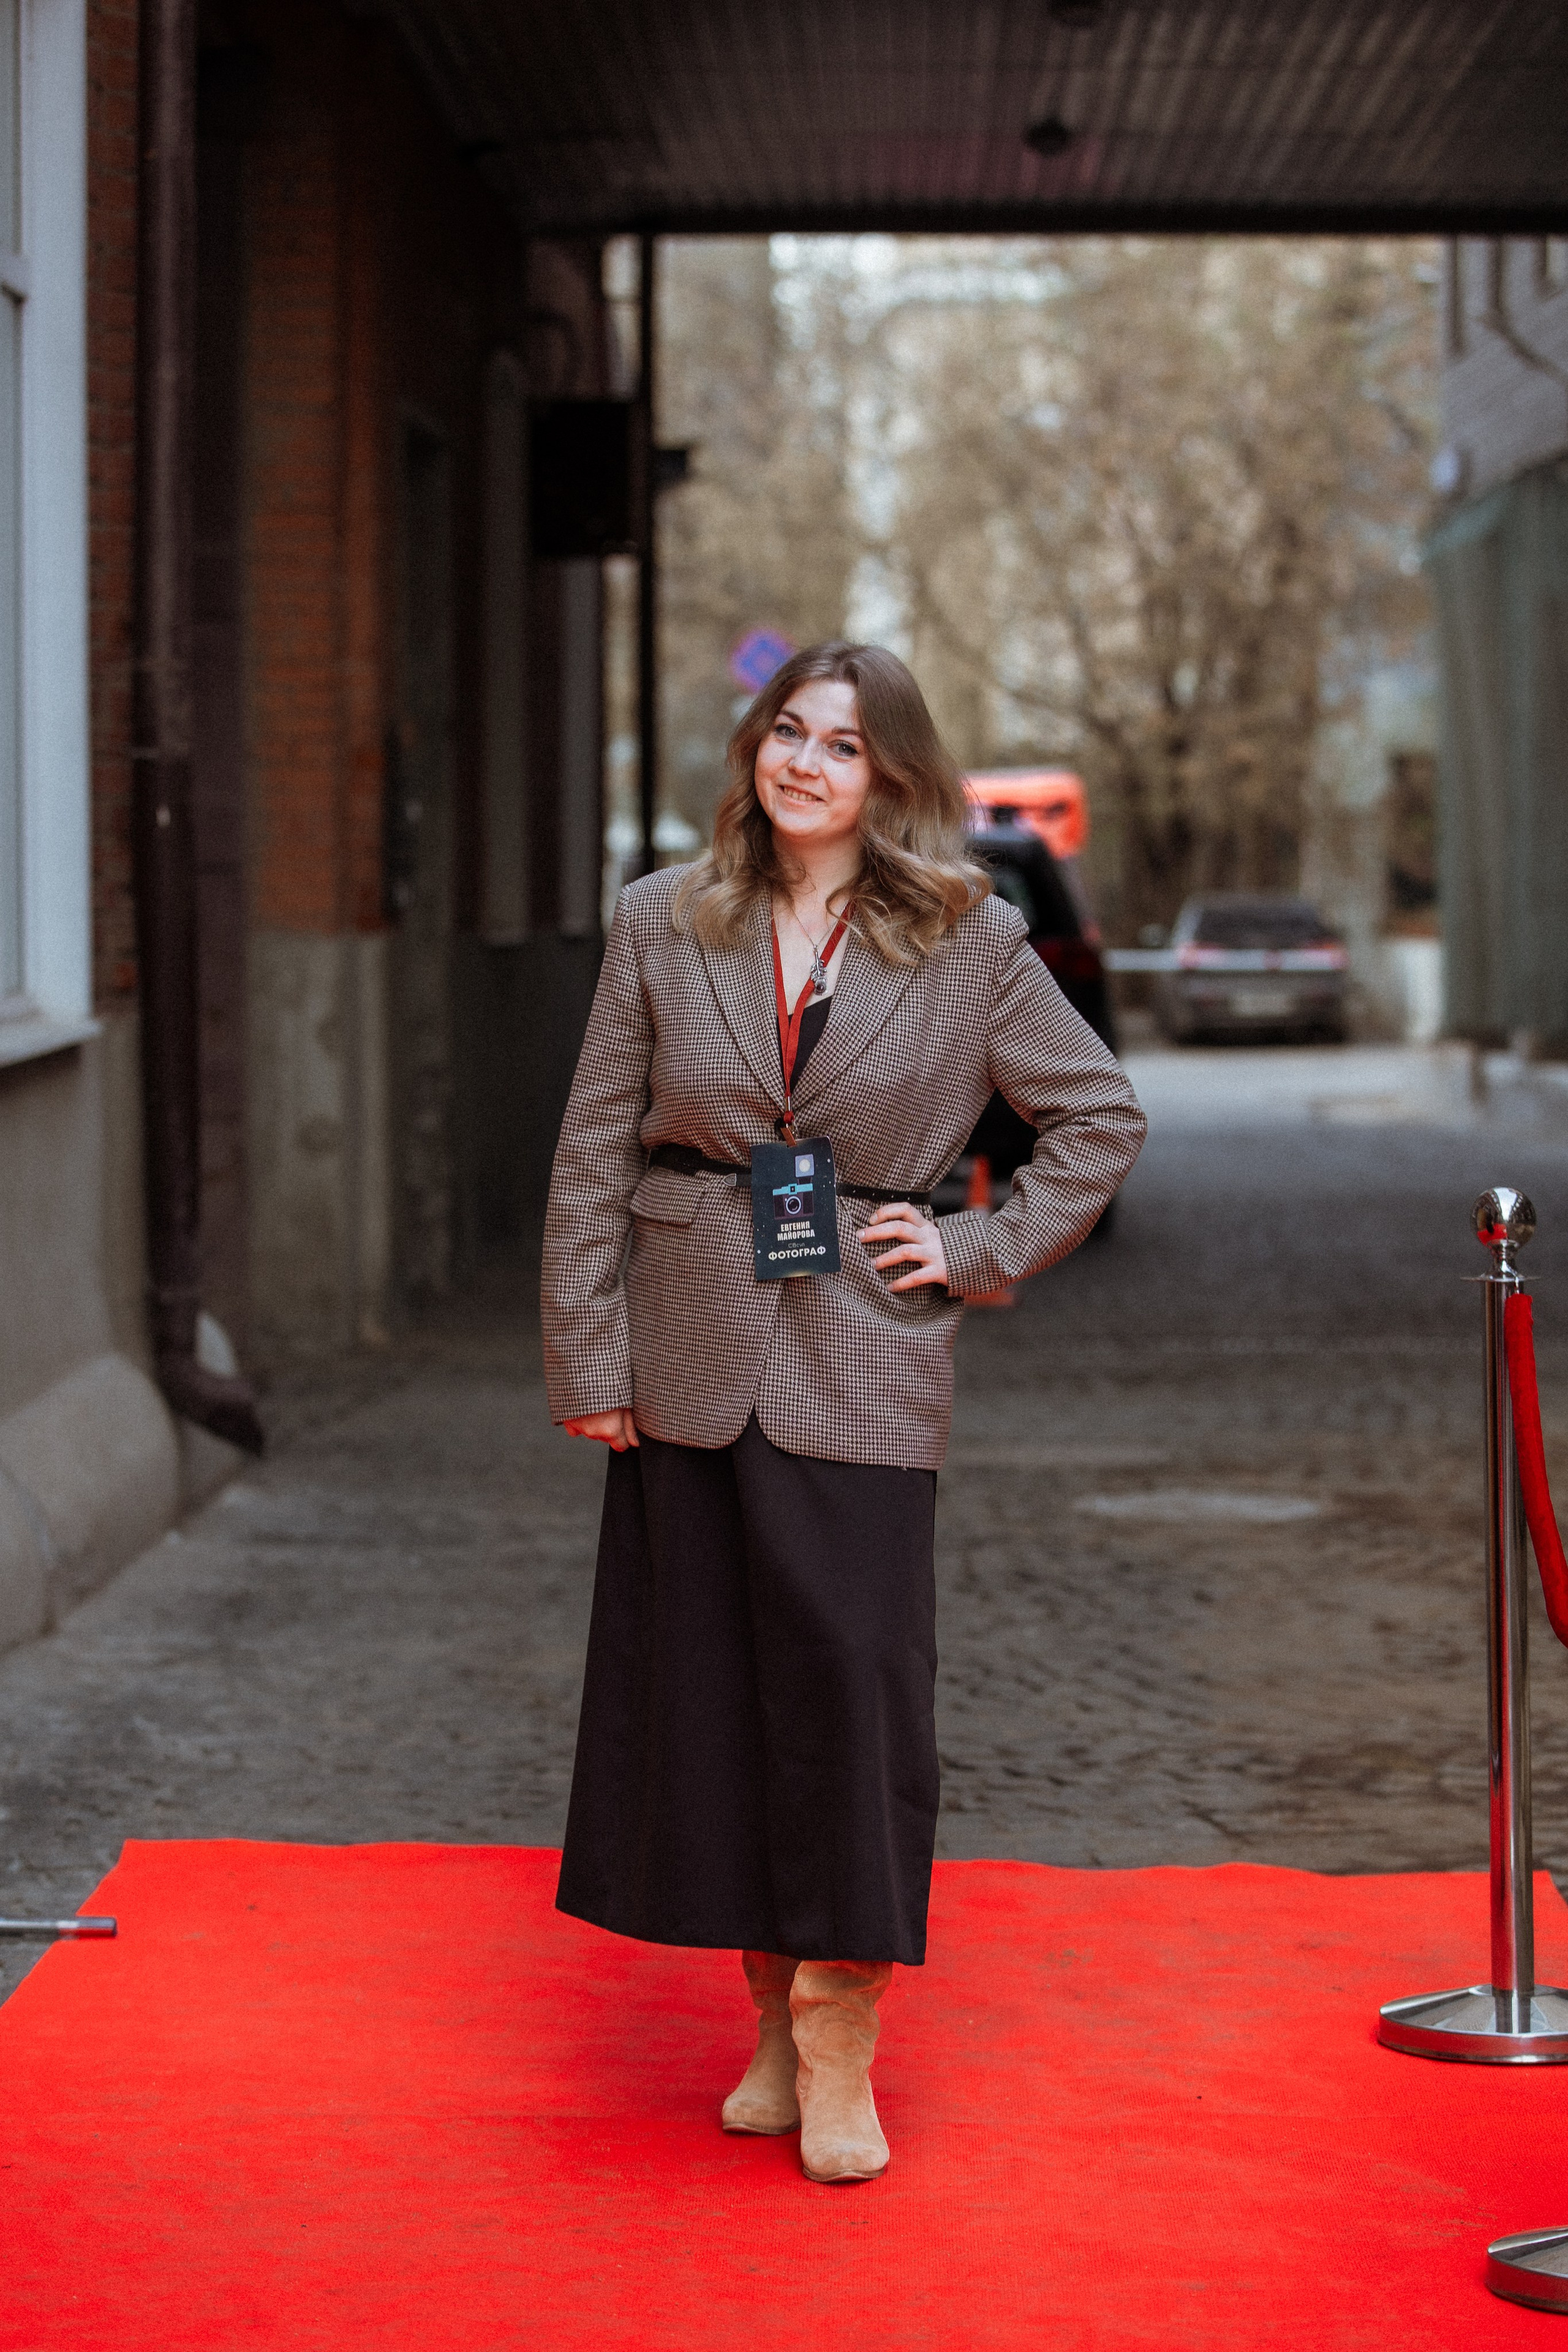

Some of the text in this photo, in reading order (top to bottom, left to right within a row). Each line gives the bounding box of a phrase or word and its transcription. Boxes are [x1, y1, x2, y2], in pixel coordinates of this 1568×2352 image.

[781, 1221, 810, 1232] ЕВГЕНИЯ
[777, 1229, 815, 1241] МАЙОРОВА
[768, 1246, 826, 1261] ФОТОГРАФ
